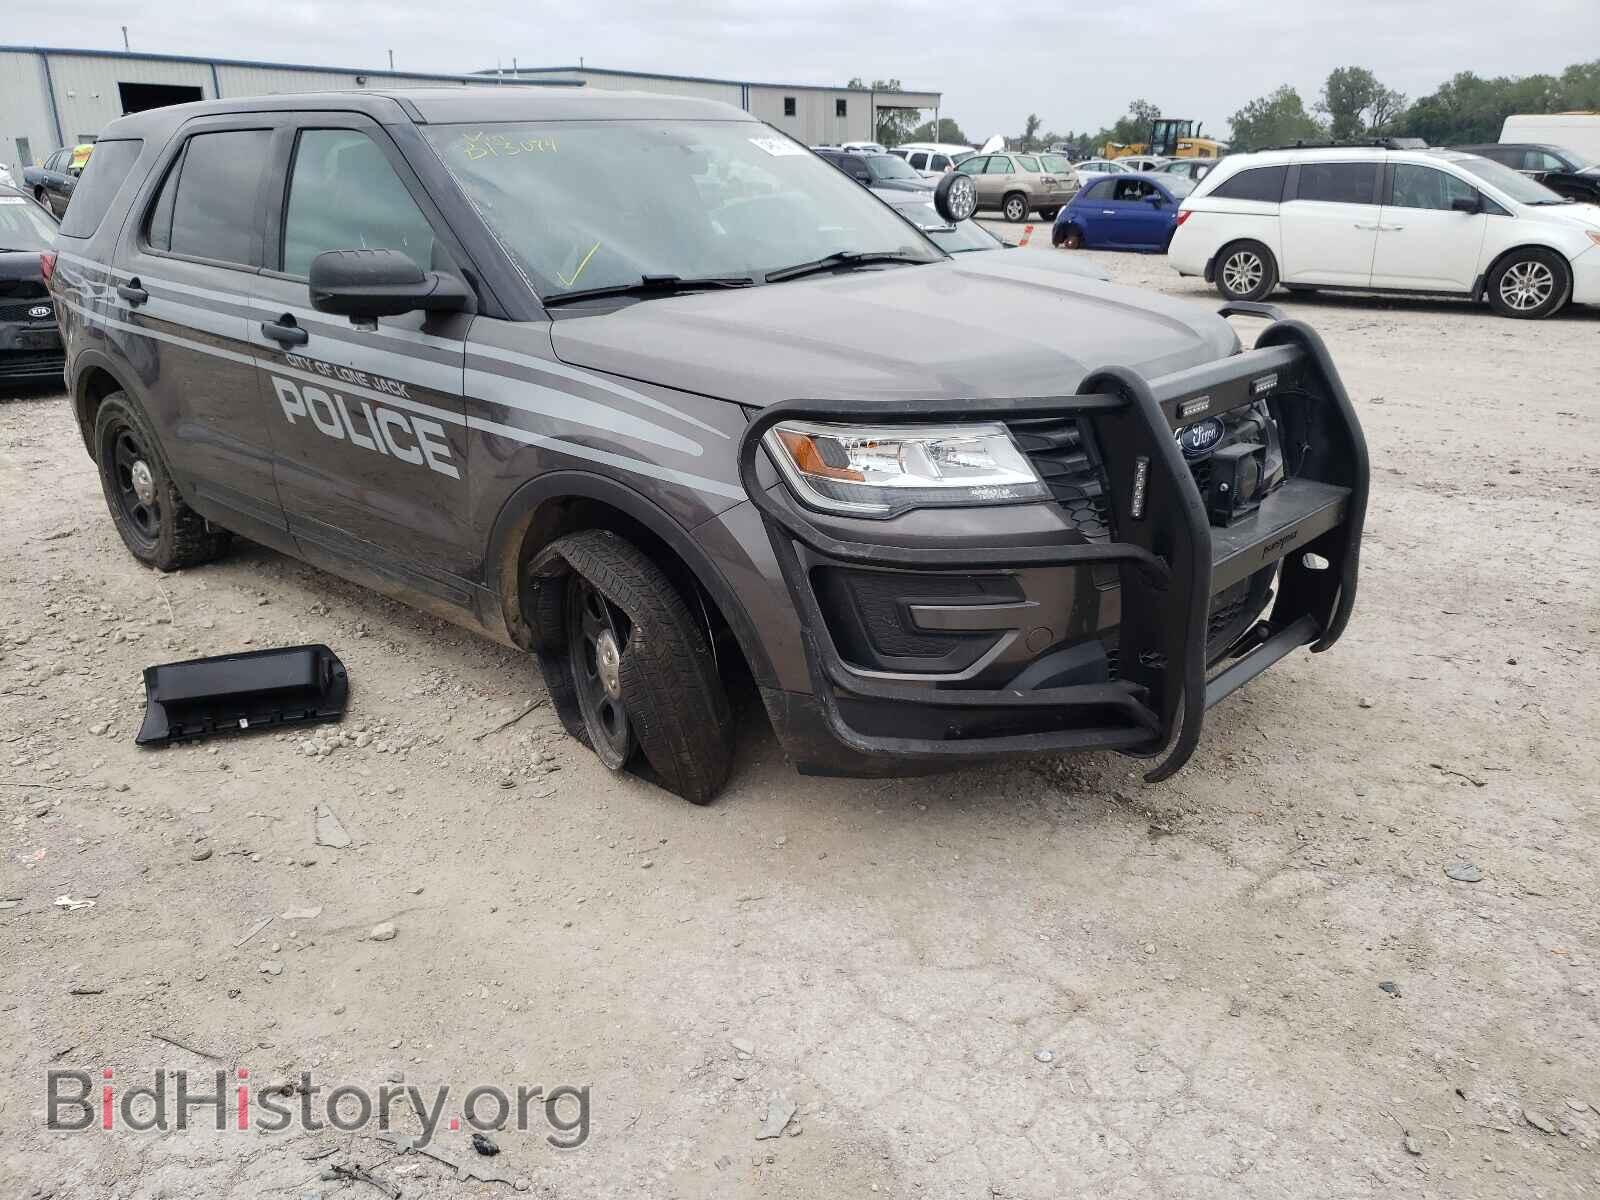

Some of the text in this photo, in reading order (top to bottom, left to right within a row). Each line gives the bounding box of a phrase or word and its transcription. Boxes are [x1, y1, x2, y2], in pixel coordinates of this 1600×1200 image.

[287, 353, 411, 399] CITY OF LONE JACK
[271, 375, 461, 480] POLICE
[1192, 424, 1219, 447] Ford
